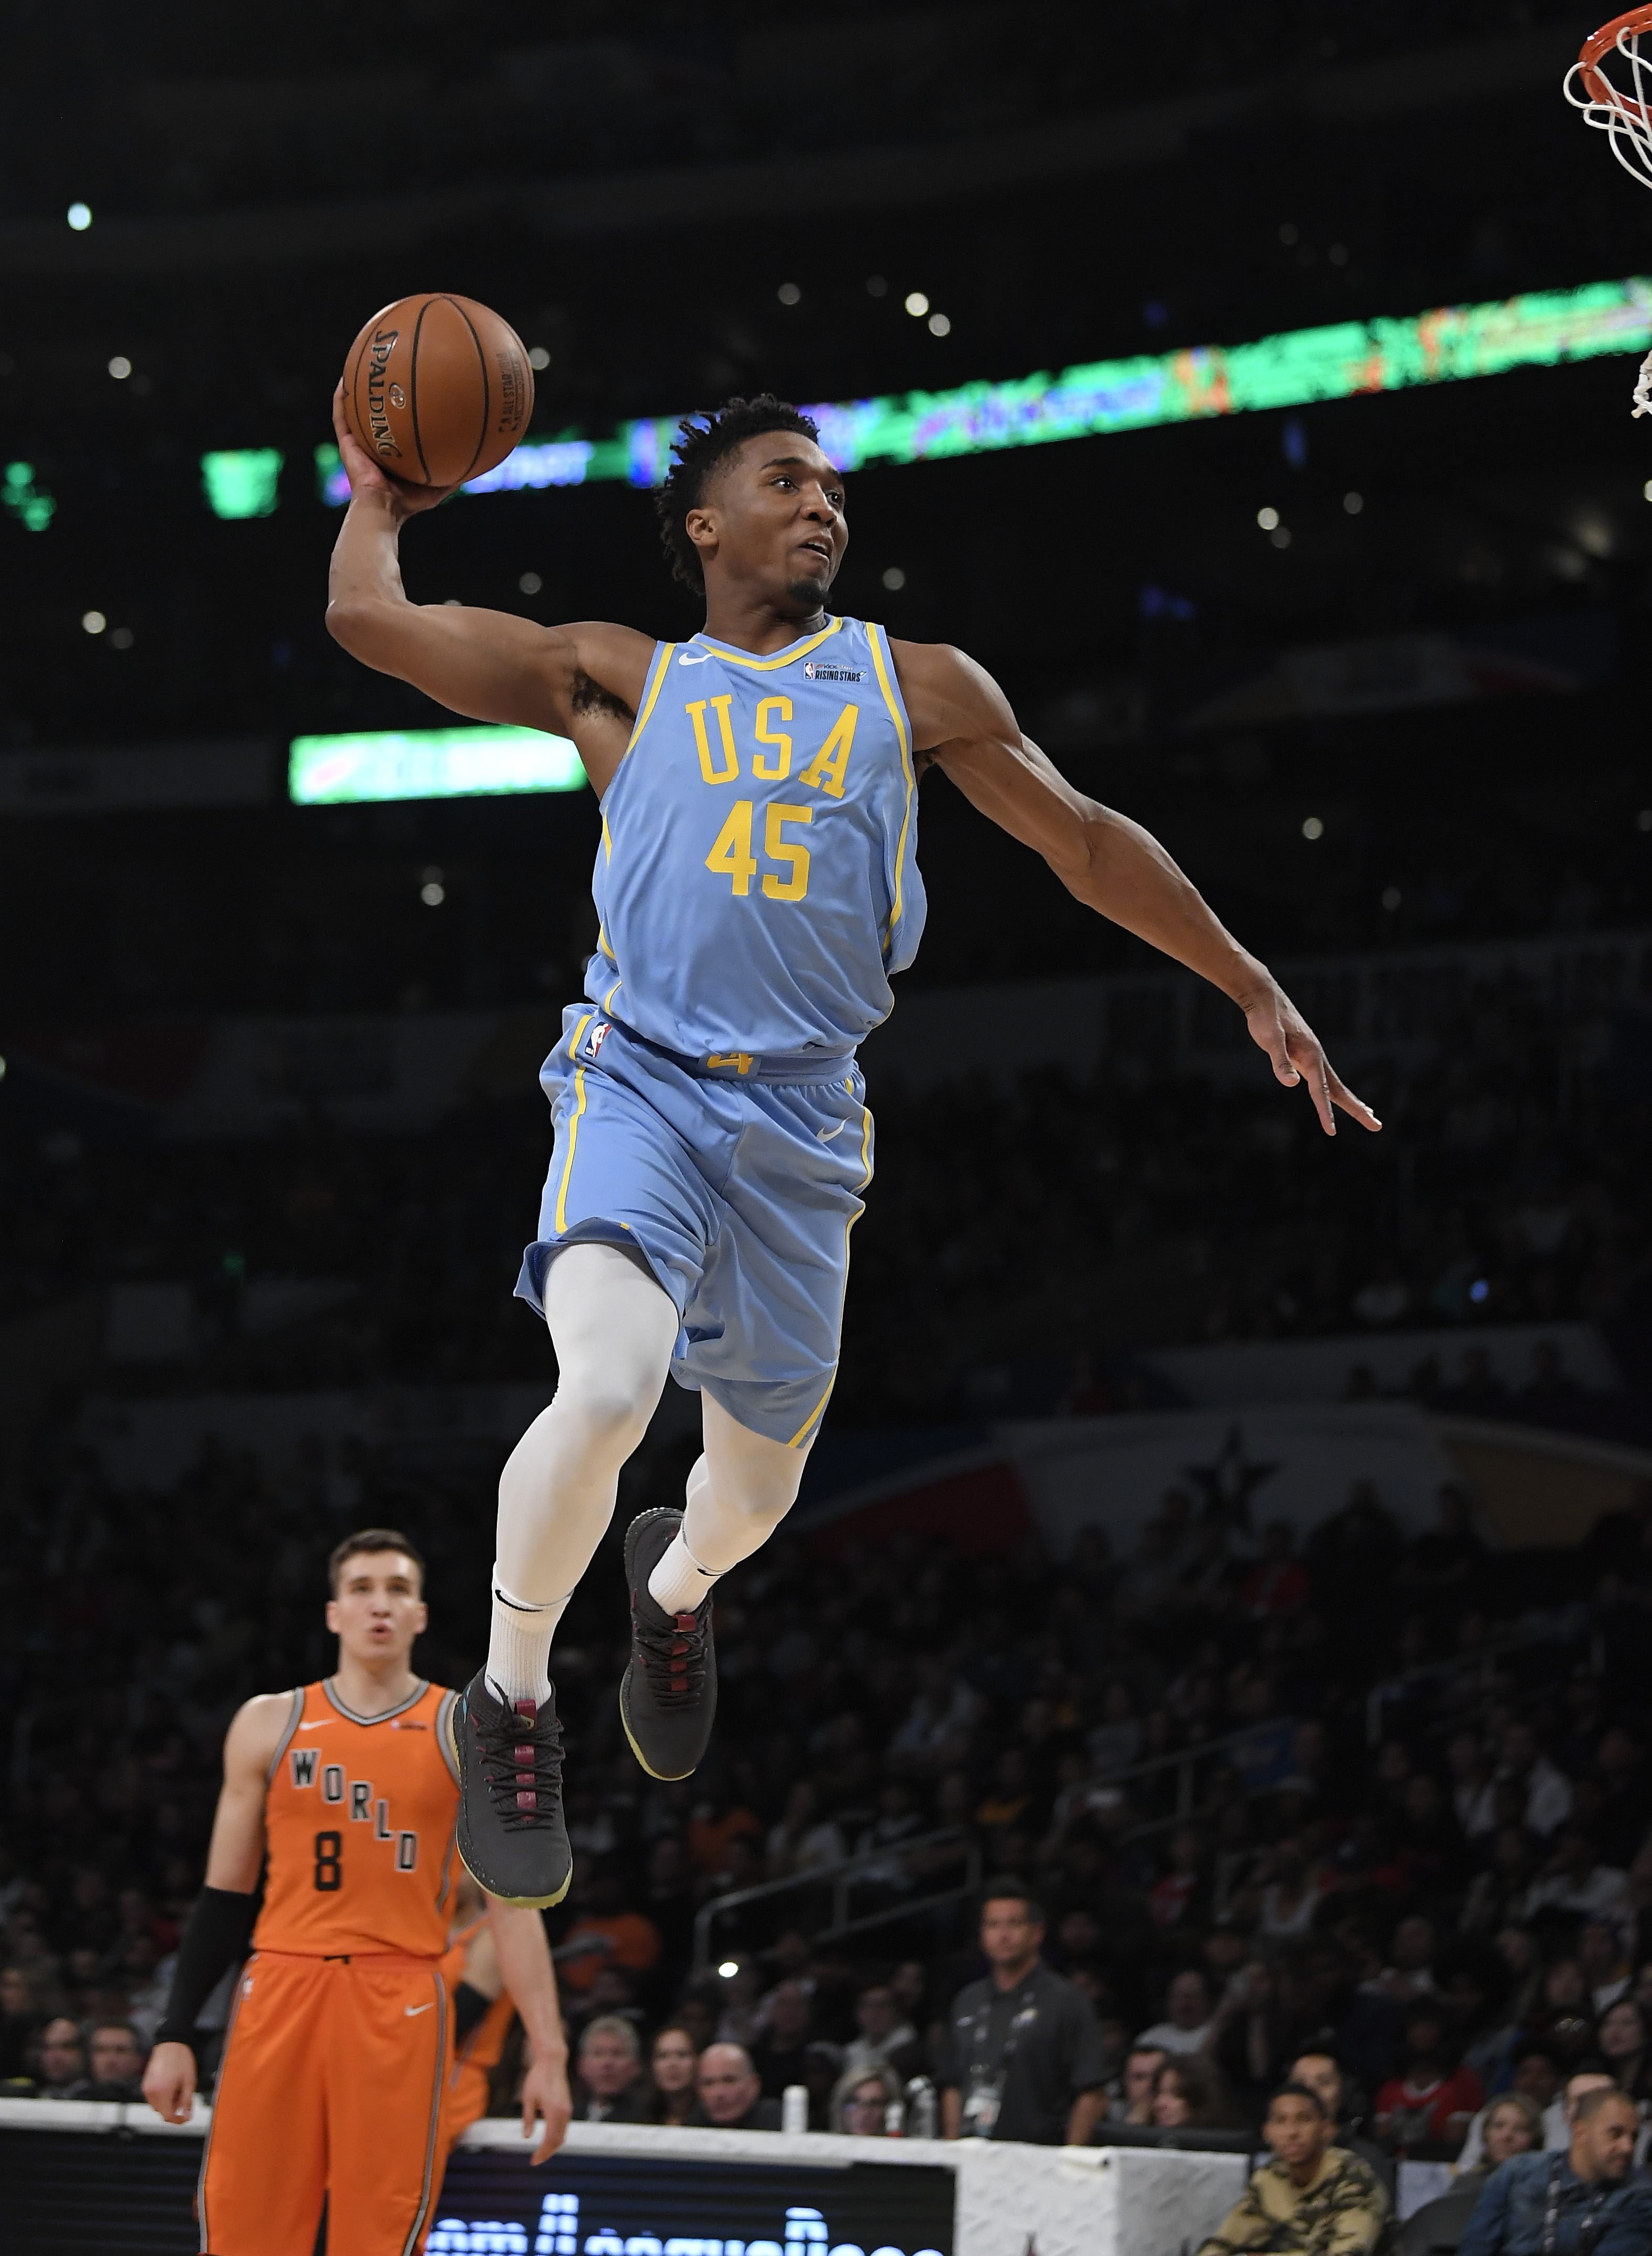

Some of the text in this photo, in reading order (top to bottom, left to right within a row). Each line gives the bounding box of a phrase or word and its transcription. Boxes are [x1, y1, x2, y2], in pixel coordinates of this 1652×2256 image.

[368, 330, 402, 457] SPALDING
[502, 374, 514, 398] STAR
[815, 670, 860, 682] RISING STARS
[686, 694, 859, 799] USA
[705, 800, 812, 901] 45
[290, 1749, 418, 1871] WORLD
[316, 1831, 341, 1891] 8
